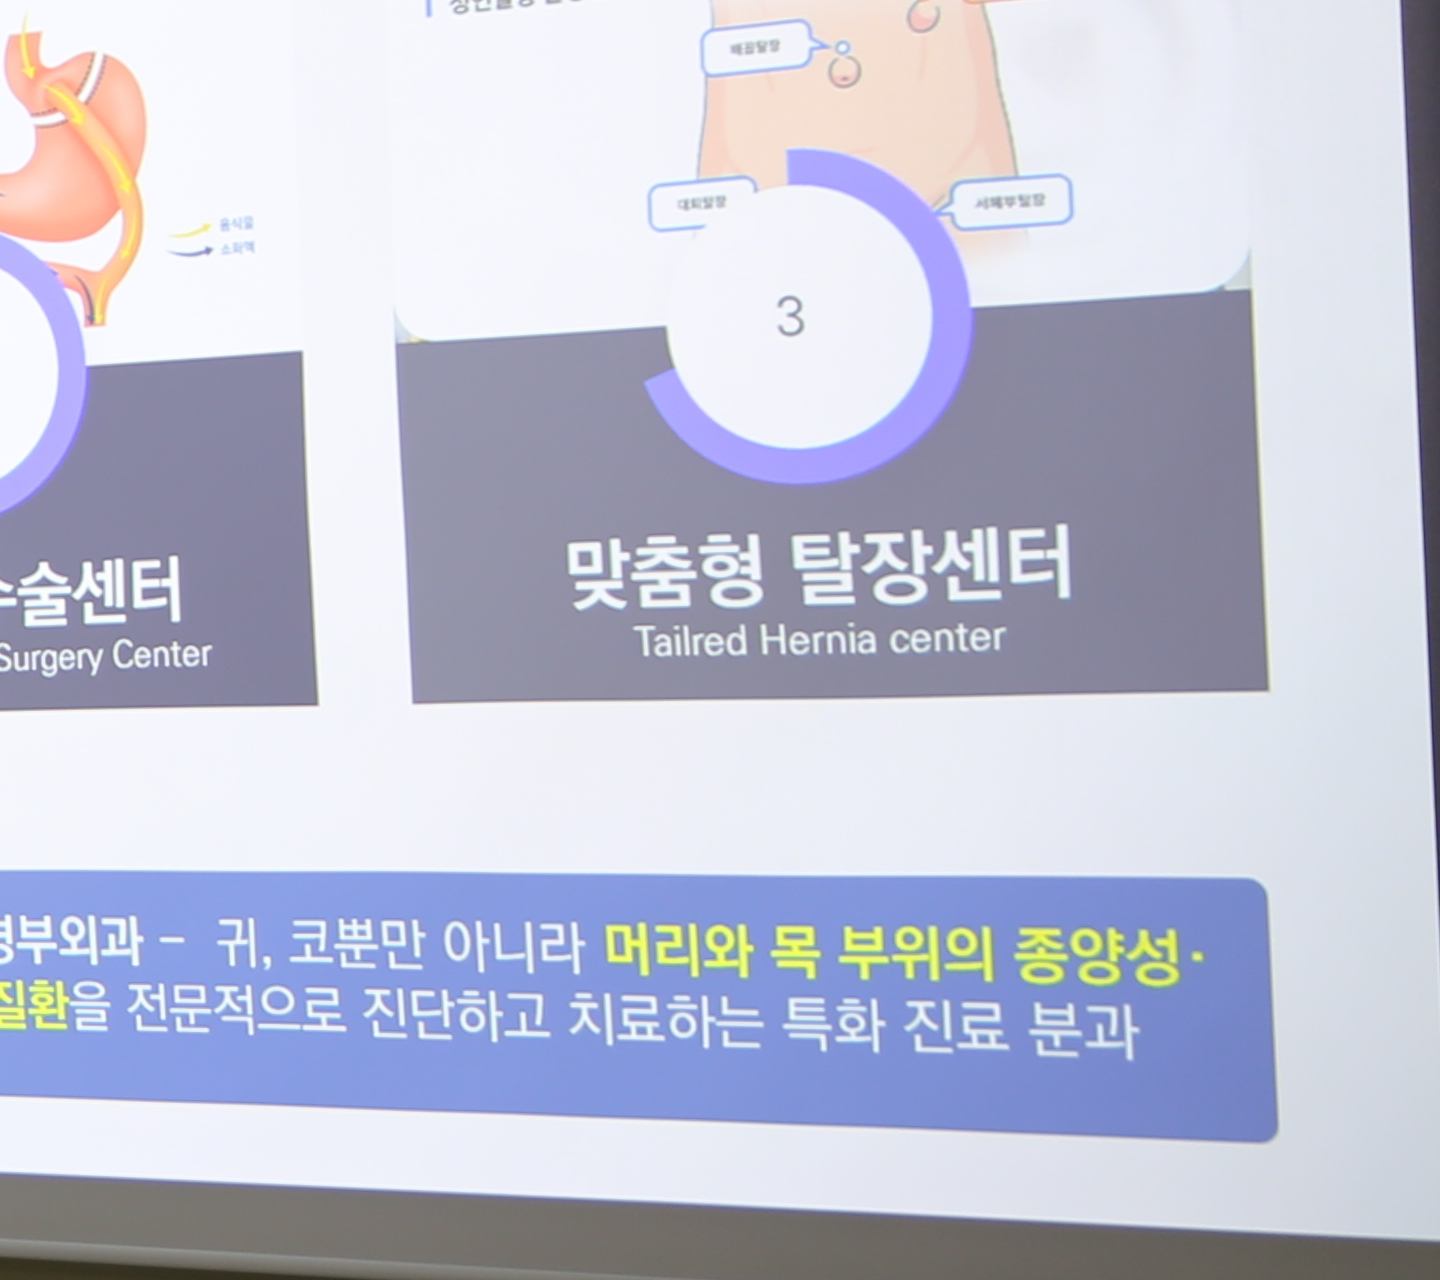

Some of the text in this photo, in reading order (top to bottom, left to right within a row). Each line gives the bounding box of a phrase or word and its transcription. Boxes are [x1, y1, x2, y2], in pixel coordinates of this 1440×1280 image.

[778, 296, 804, 337] 3
[568, 524, 1070, 610] 맞춤형 탈장센터
[113, 639, 212, 668] Center
[633, 623, 1006, 657] Tailred Hernia center
[217, 918, 271, 970] 귀,
[290, 919, 426, 970] 코뿐만
[445, 921, 585, 974] 아니라
[606, 922, 754, 978] 머리와
[771, 926, 821, 979] 목
[839, 926, 993, 982] 부위의
[128, 983, 346, 1035] 전문적으로
[364, 988, 550, 1042] 진단하고
[570, 993, 764, 1048] 치료하는
[783, 998, 886, 1053] 특화
[904, 1000, 1009, 1053] 진료
[1029, 1002, 1139, 1060] 분과
